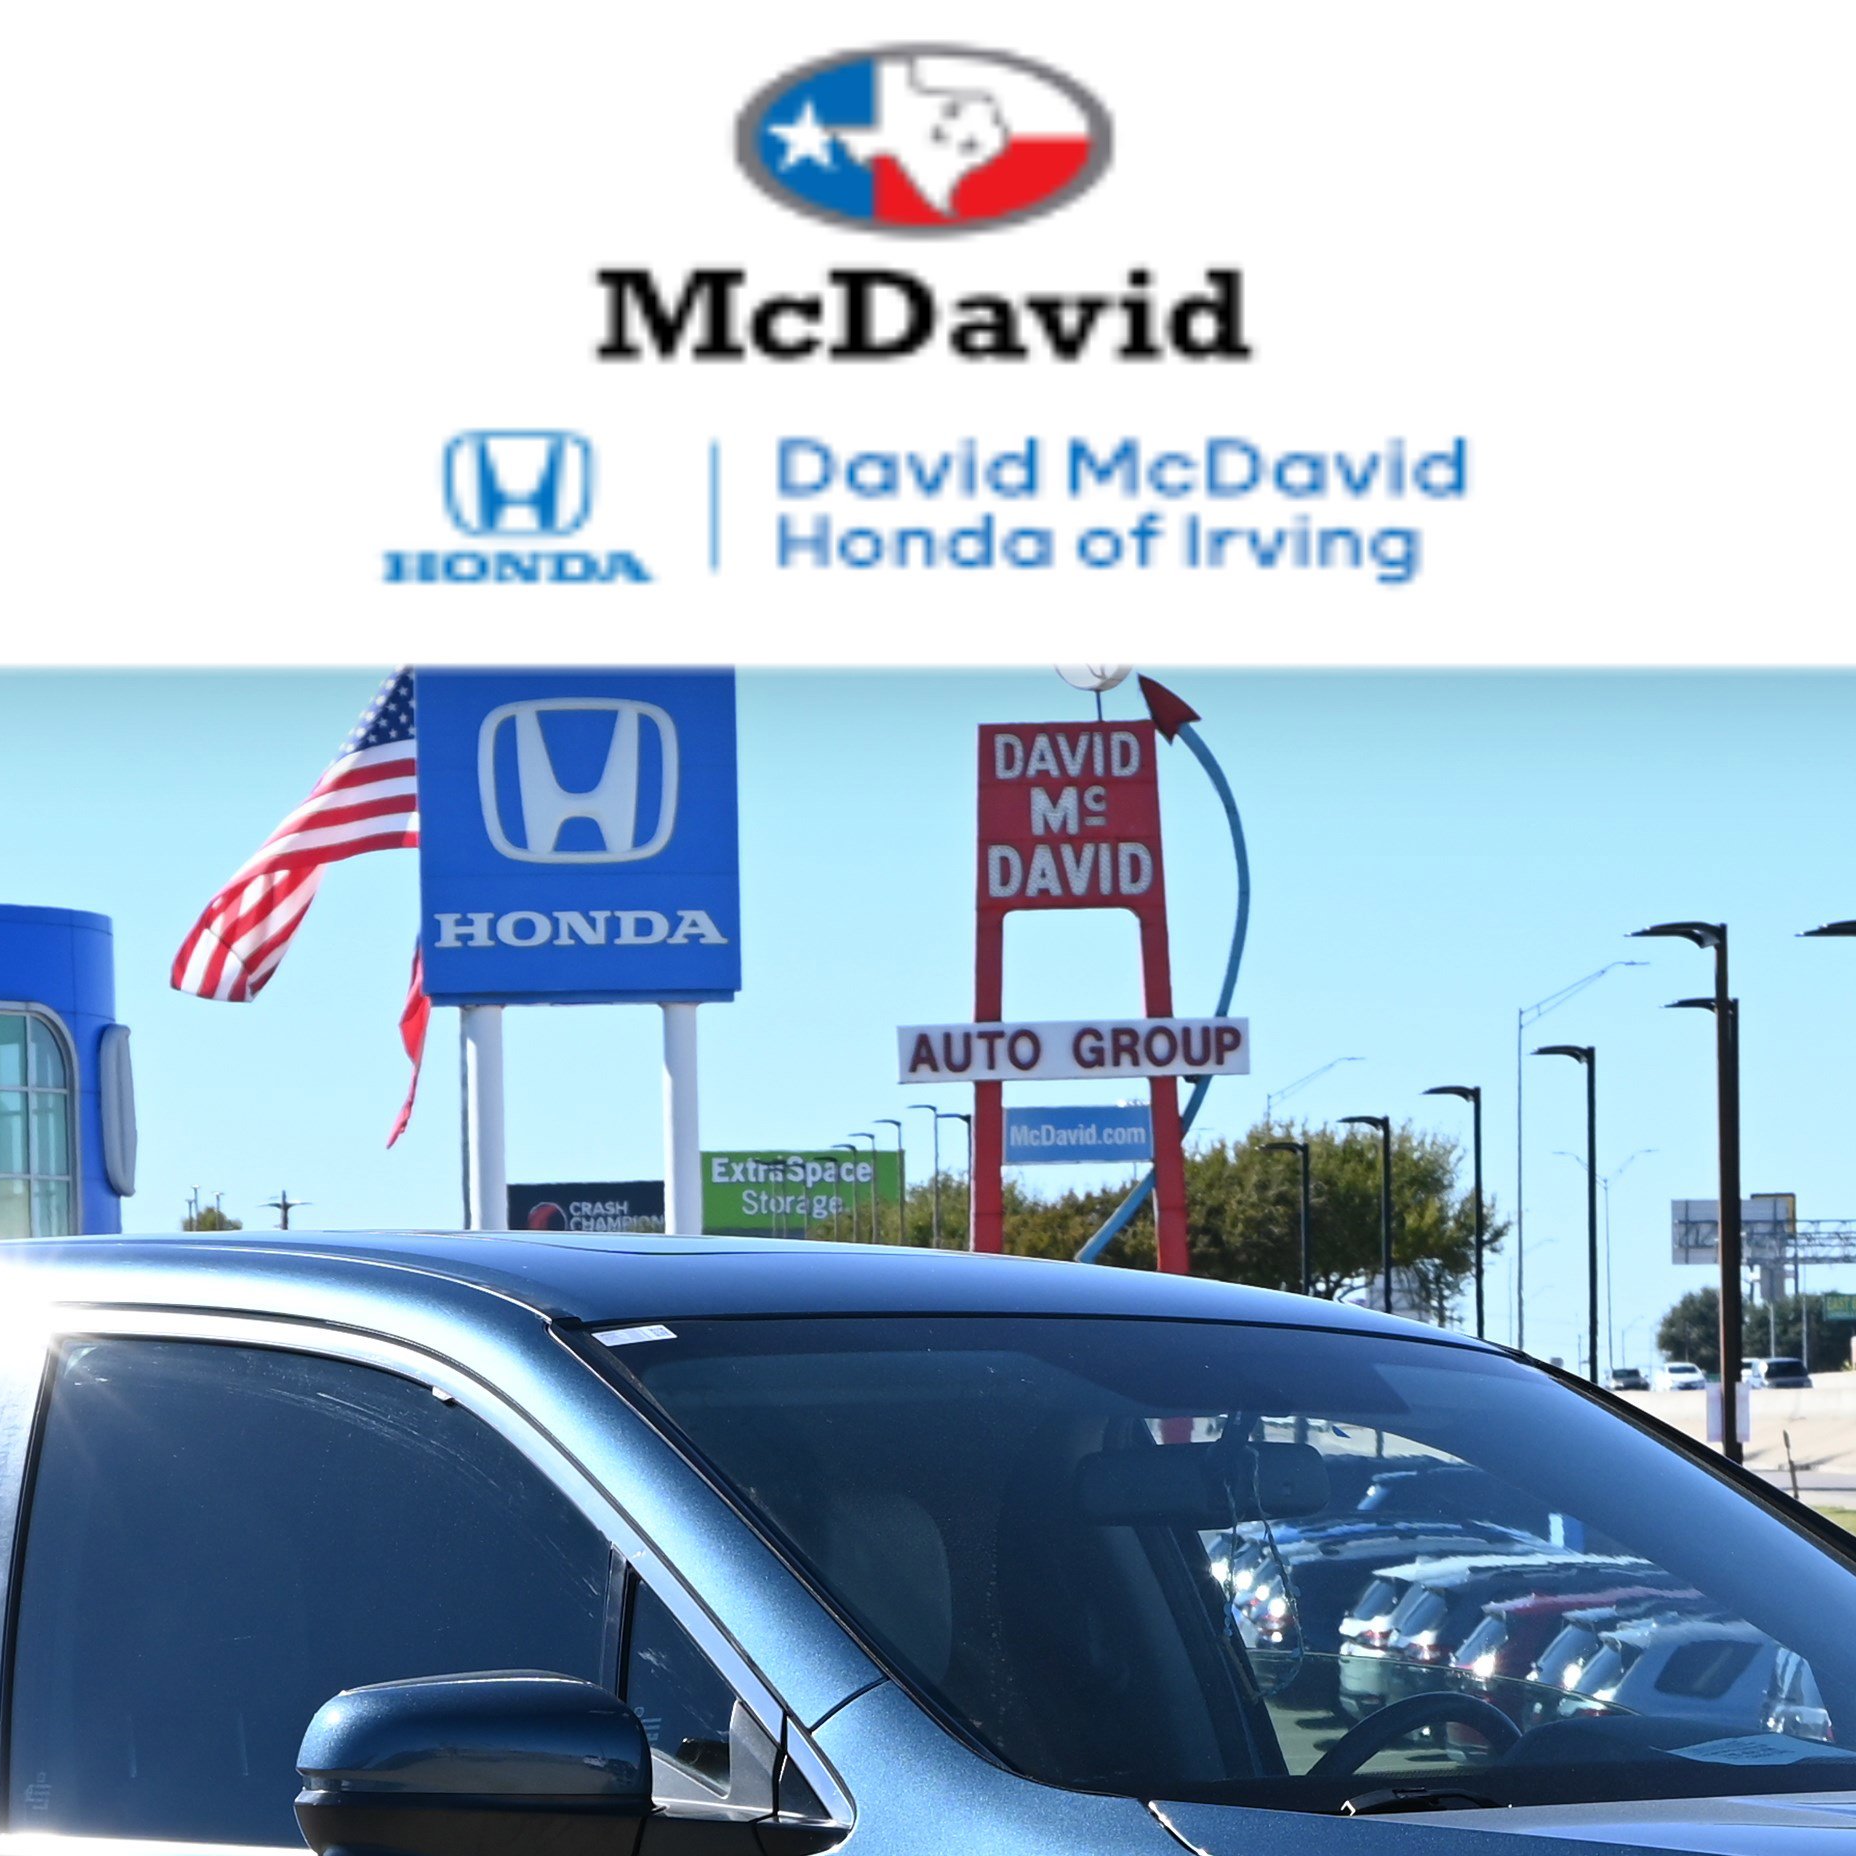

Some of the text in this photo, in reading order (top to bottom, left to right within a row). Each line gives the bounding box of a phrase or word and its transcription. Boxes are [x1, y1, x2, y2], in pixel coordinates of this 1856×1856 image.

[994, 731, 1140, 779] DAVID
[988, 842, 1153, 898] DAVID
[433, 909, 728, 948] HONDA
[908, 1026, 1242, 1074] AUTO GROUP
[1010, 1123, 1146, 1147] McDavid.com
[569, 1201, 629, 1216] CRASH
[742, 1189, 843, 1219] Storage
